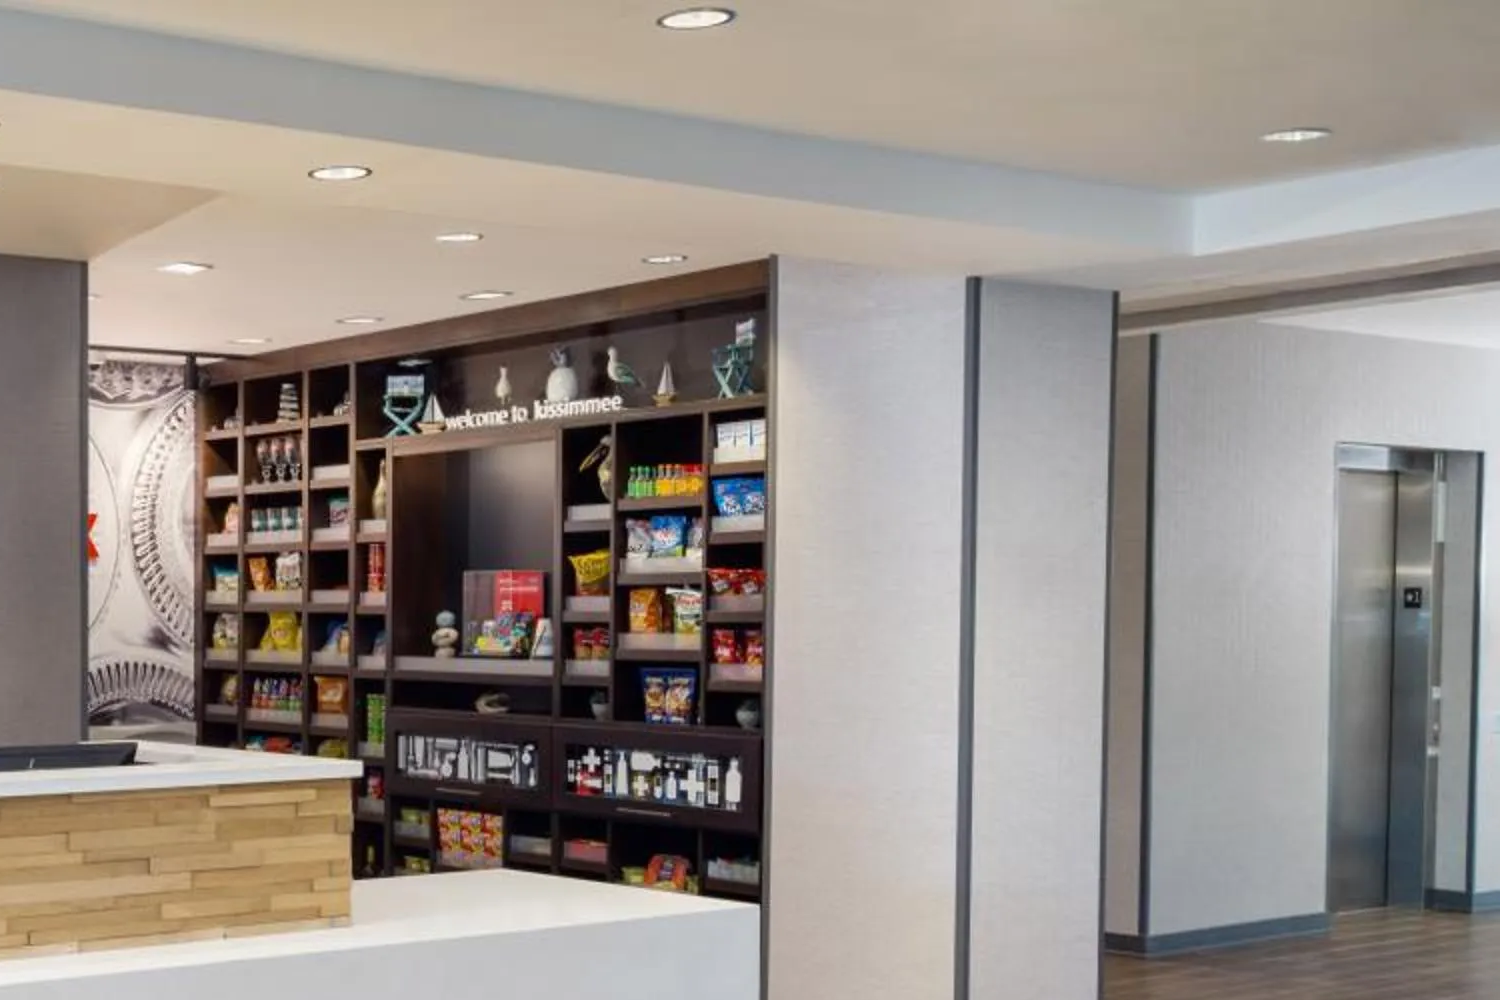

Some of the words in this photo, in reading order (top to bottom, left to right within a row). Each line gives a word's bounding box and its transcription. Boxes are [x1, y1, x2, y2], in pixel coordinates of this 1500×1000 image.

[445, 409, 509, 430] welcome
[511, 405, 528, 422] to
[533, 395, 623, 420] kissimmee
